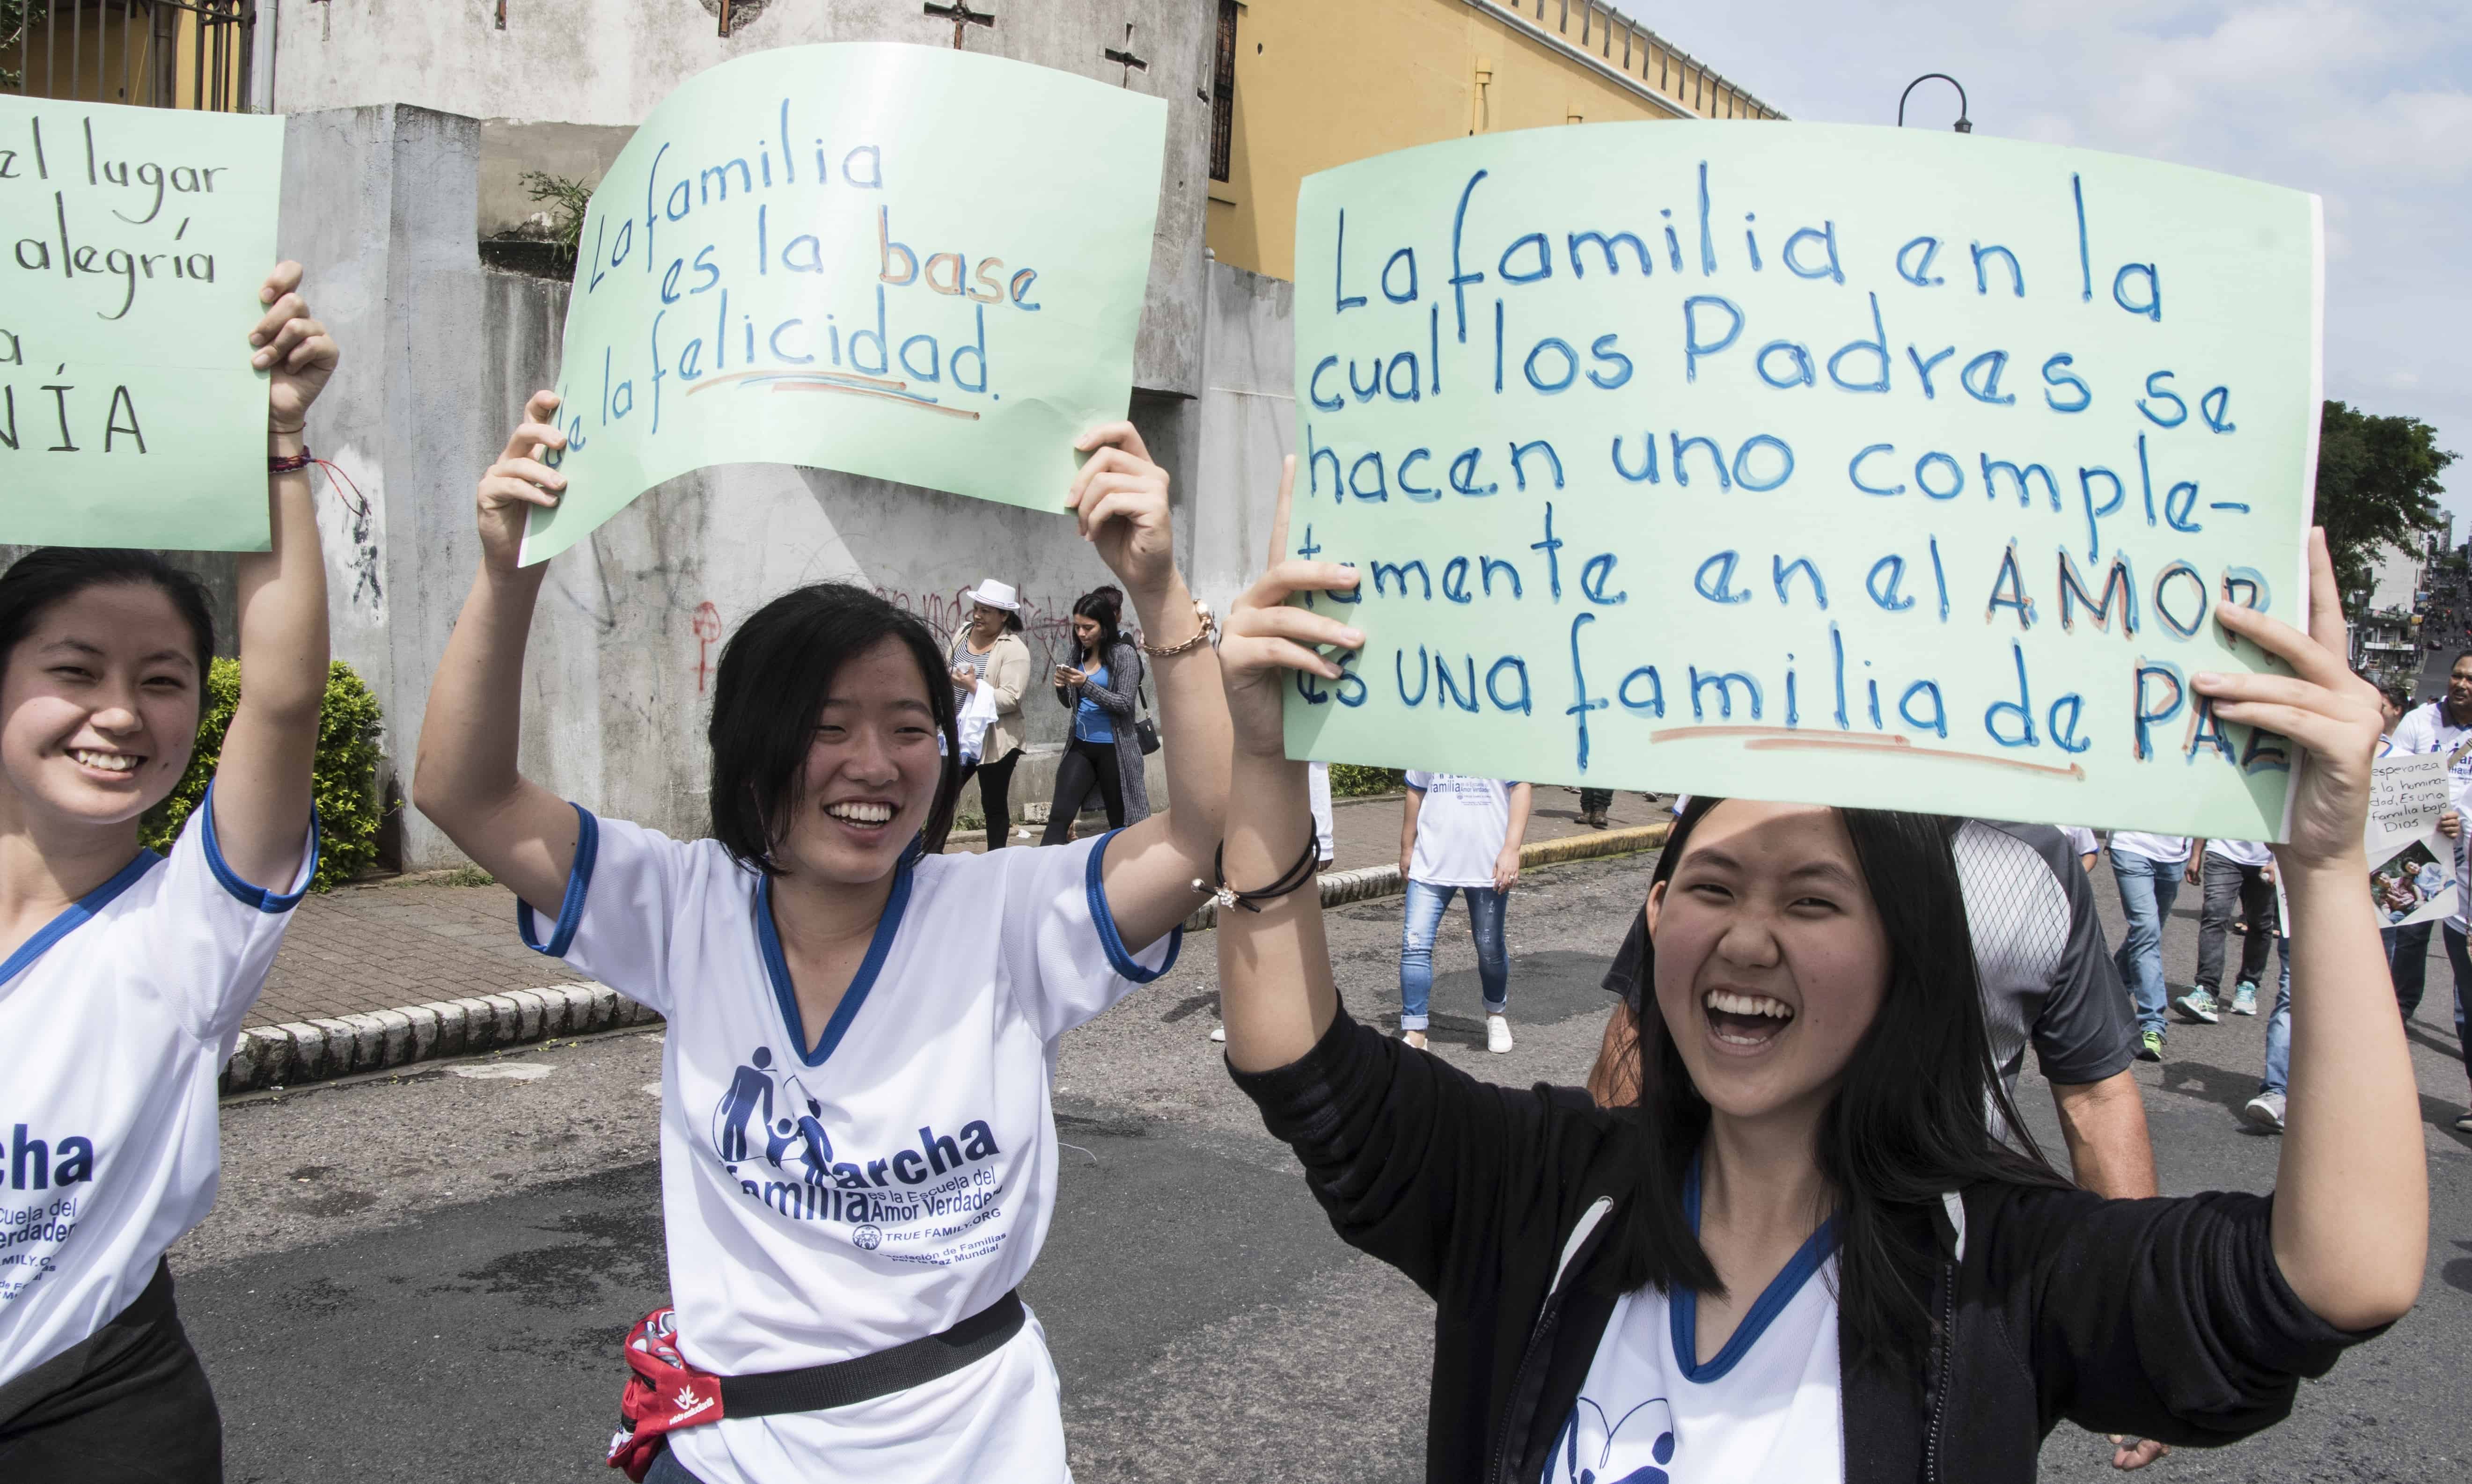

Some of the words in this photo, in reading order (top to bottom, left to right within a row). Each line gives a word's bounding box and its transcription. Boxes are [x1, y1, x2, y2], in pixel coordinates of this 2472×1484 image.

[83, 116, 228, 225] lugar
[589, 214, 632, 293] La
[646, 98, 882, 272] familia
[15, 190, 214, 320] alegría
[660, 244, 720, 306] es
[758, 204, 823, 275] la
[877, 204, 1041, 312] base
[1336, 207, 1418, 314] La
[1448, 160, 1846, 343] familia
[1896, 236, 2025, 298] en
[2071, 172, 2162, 322] la
[603, 346, 632, 427] la
[652, 282, 1001, 435] felicidad.
[1310, 301, 1441, 412] cual
[1494, 297, 1634, 395] los
[1683, 291, 2092, 413] Padres
[2135, 369, 2237, 434] se
[1306, 423, 1565, 505] hacen
[1611, 430, 1795, 494] uno
[1848, 430, 2251, 563] comple-
[1297, 501, 1628, 609] tamente
[1694, 550, 1828, 611] en
[1865, 534, 1950, 623] el
[1565, 620, 1949, 774] familia
[1984, 637, 2091, 754] de
[2371, 762, 2440, 781] esperanza
[2381, 782, 2393, 793] la
[2372, 804, 2418, 822] familia
[2422, 802, 2447, 815] bajo
[2384, 819, 2419, 833] Dios
[49, 1198, 77, 1217] del
[867, 1192, 887, 1200] es
[888, 1190, 903, 1203] la
[907, 1176, 969, 1203] Escuela
[973, 1165, 996, 1185] del
[870, 1200, 919, 1222] Amor
[886, 1231, 922, 1242] TRUE
[924, 1208, 1001, 1238] FAMILY.ORG
[954, 1243, 998, 1262] Mundial
[960, 1233, 1007, 1252] Familias
